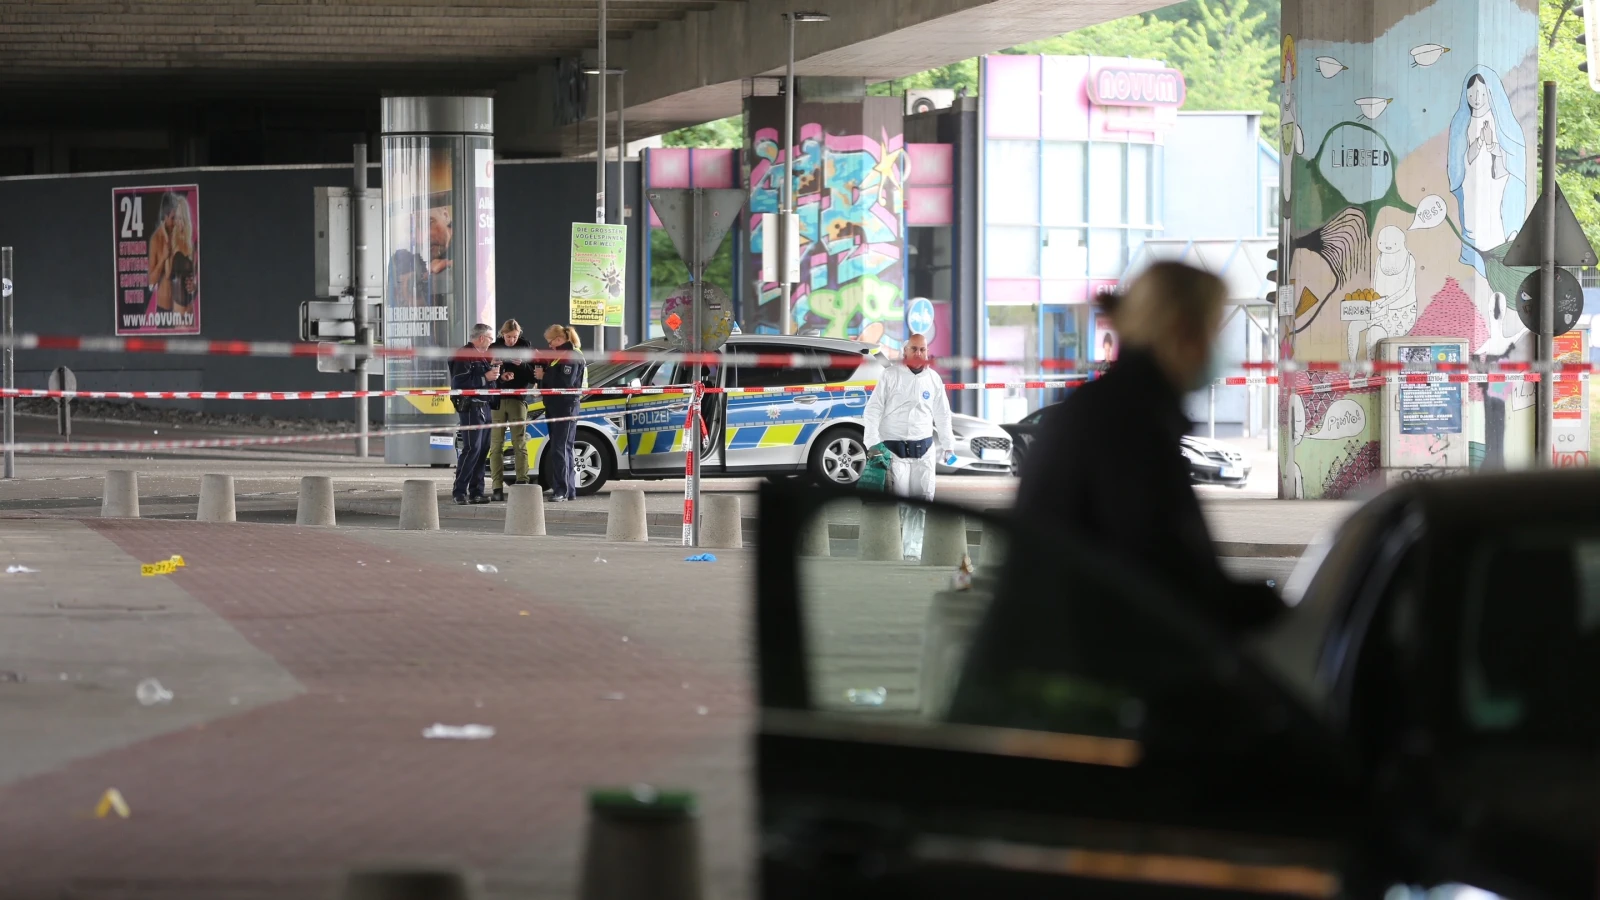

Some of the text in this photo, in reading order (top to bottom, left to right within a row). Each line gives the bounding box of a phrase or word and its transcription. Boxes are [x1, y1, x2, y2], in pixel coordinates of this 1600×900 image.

[120, 196, 144, 238] 24
[123, 312, 194, 327] www.novum.tv
[631, 410, 670, 426] POLIZEI
